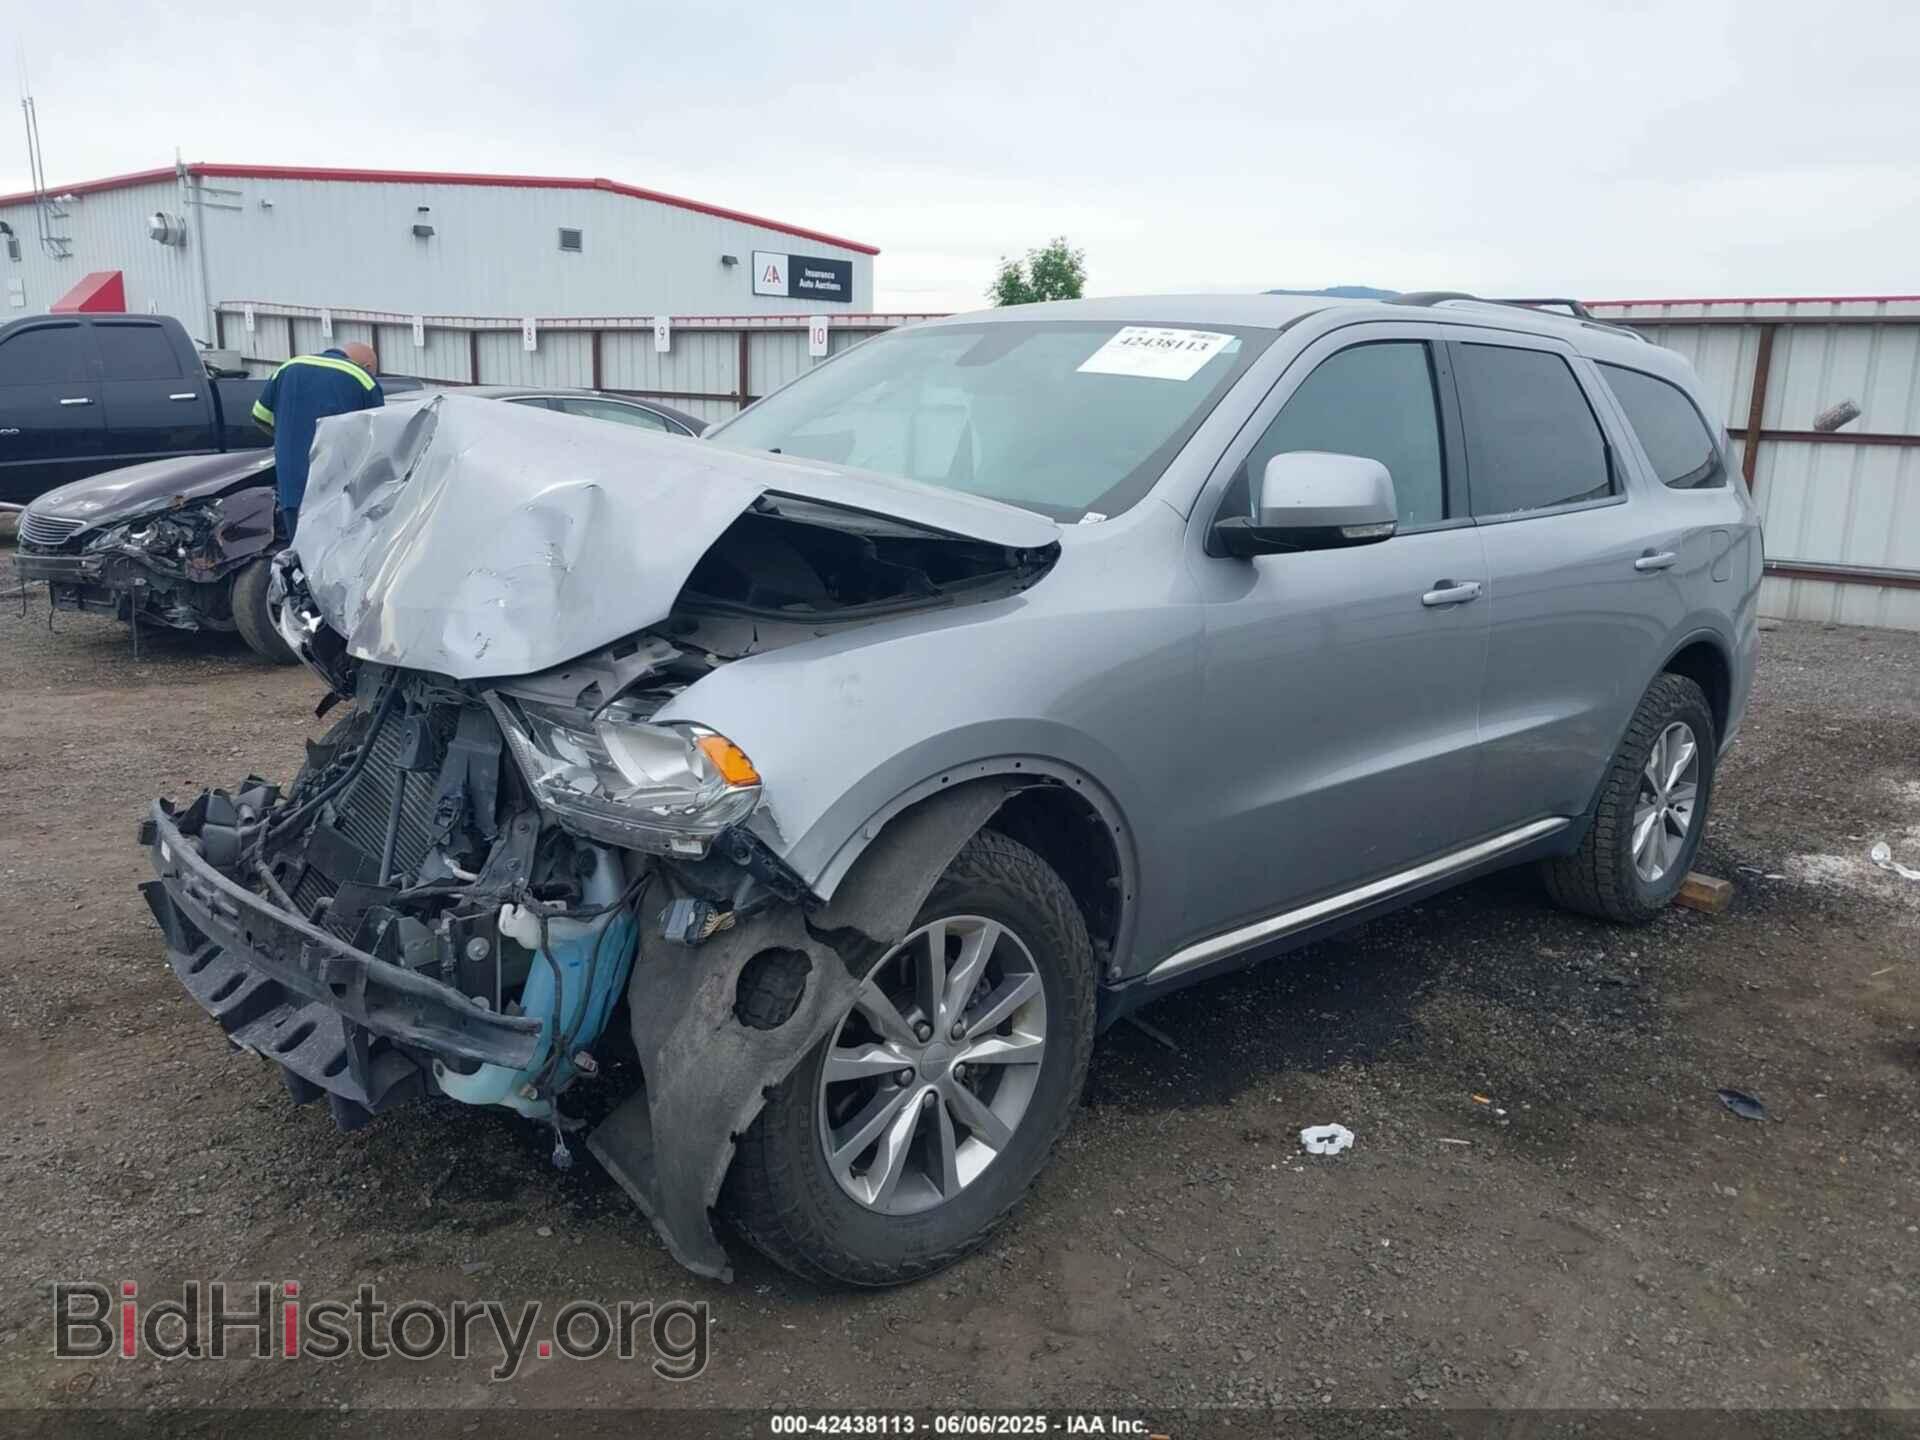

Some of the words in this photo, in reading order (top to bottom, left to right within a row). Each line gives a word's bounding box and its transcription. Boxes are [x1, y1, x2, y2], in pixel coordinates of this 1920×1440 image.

[805, 268, 835, 279] Insurance
[799, 278, 814, 288] Auto
[815, 280, 841, 291] Auctions
[812, 327, 825, 345] 10
[1120, 336, 1209, 351] 42438113
